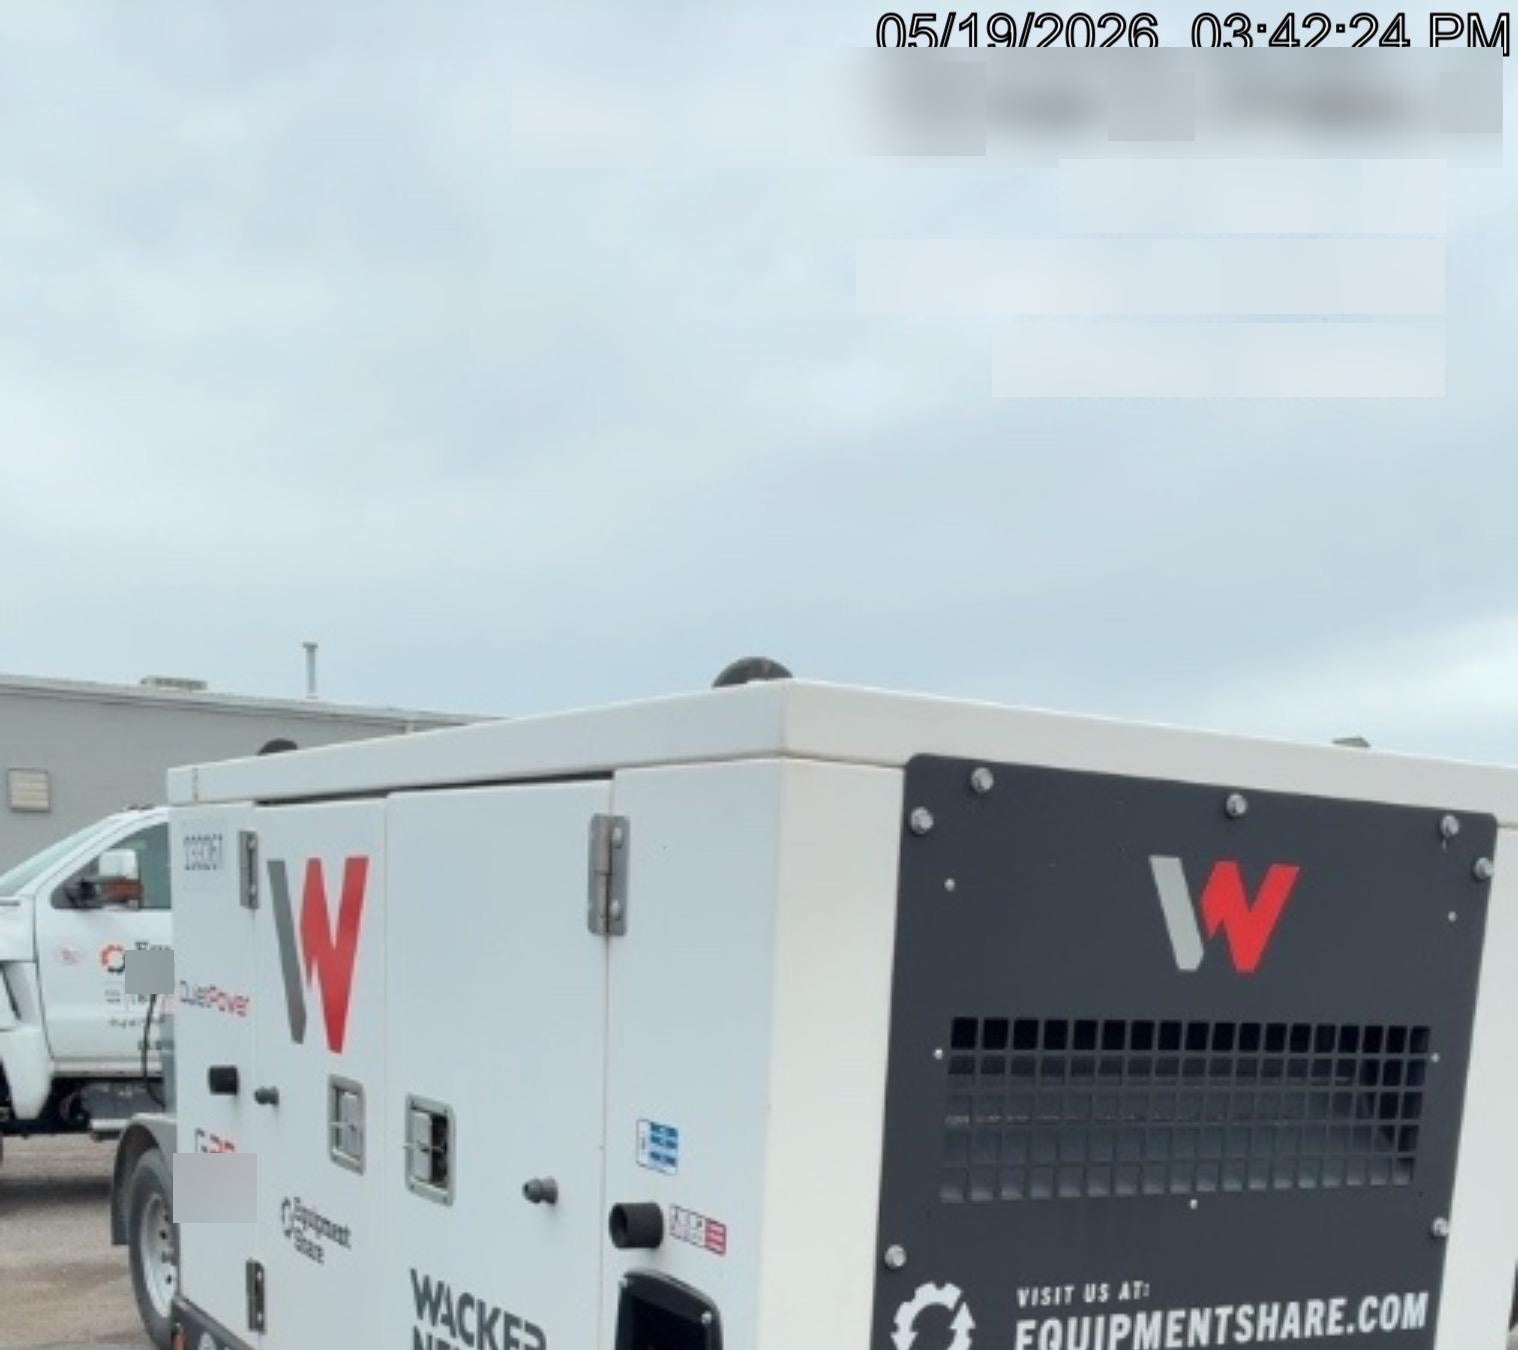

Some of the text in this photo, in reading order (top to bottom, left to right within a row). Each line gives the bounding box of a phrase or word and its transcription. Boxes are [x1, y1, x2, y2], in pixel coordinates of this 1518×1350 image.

[1017, 1281, 1150, 1308] VISIT US AT:
